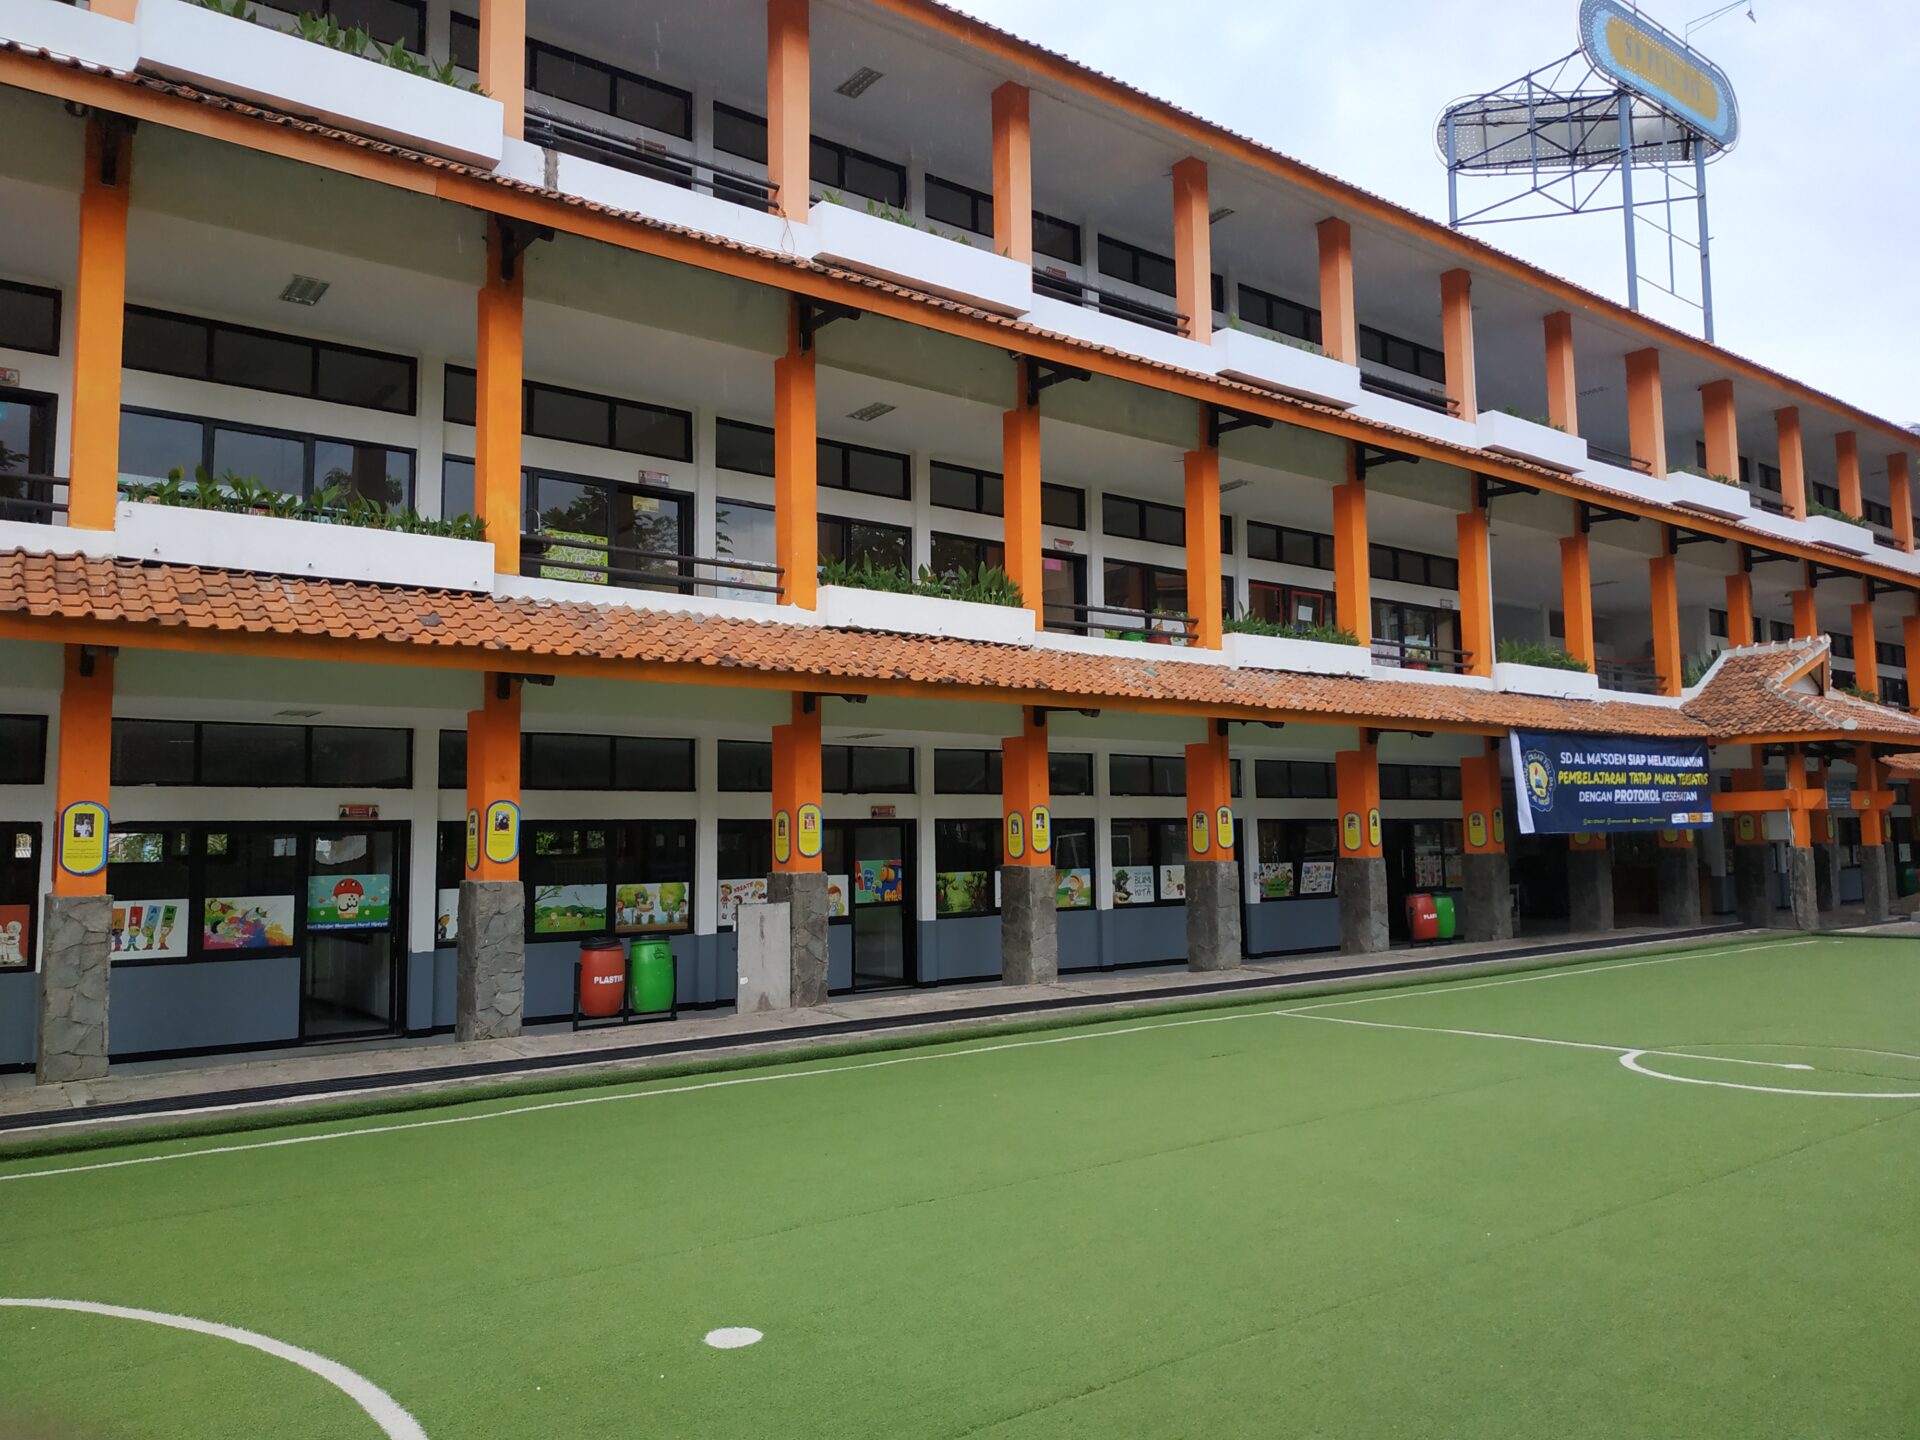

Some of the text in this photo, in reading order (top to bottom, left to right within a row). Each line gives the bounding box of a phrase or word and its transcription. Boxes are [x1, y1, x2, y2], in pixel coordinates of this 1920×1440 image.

[1560, 752, 1573, 764] SD
[1574, 752, 1586, 765] AL
[1587, 753, 1626, 765] MA'SOEM
[1628, 754, 1646, 766] SIAP
[1558, 771, 1627, 785] PEMBELAJARAN
[1628, 772, 1652, 785] TATAP
[1654, 773, 1676, 785] MUKA
[1579, 791, 1613, 802] DENGAN
[1614, 789, 1660, 802] PROTOKOL
